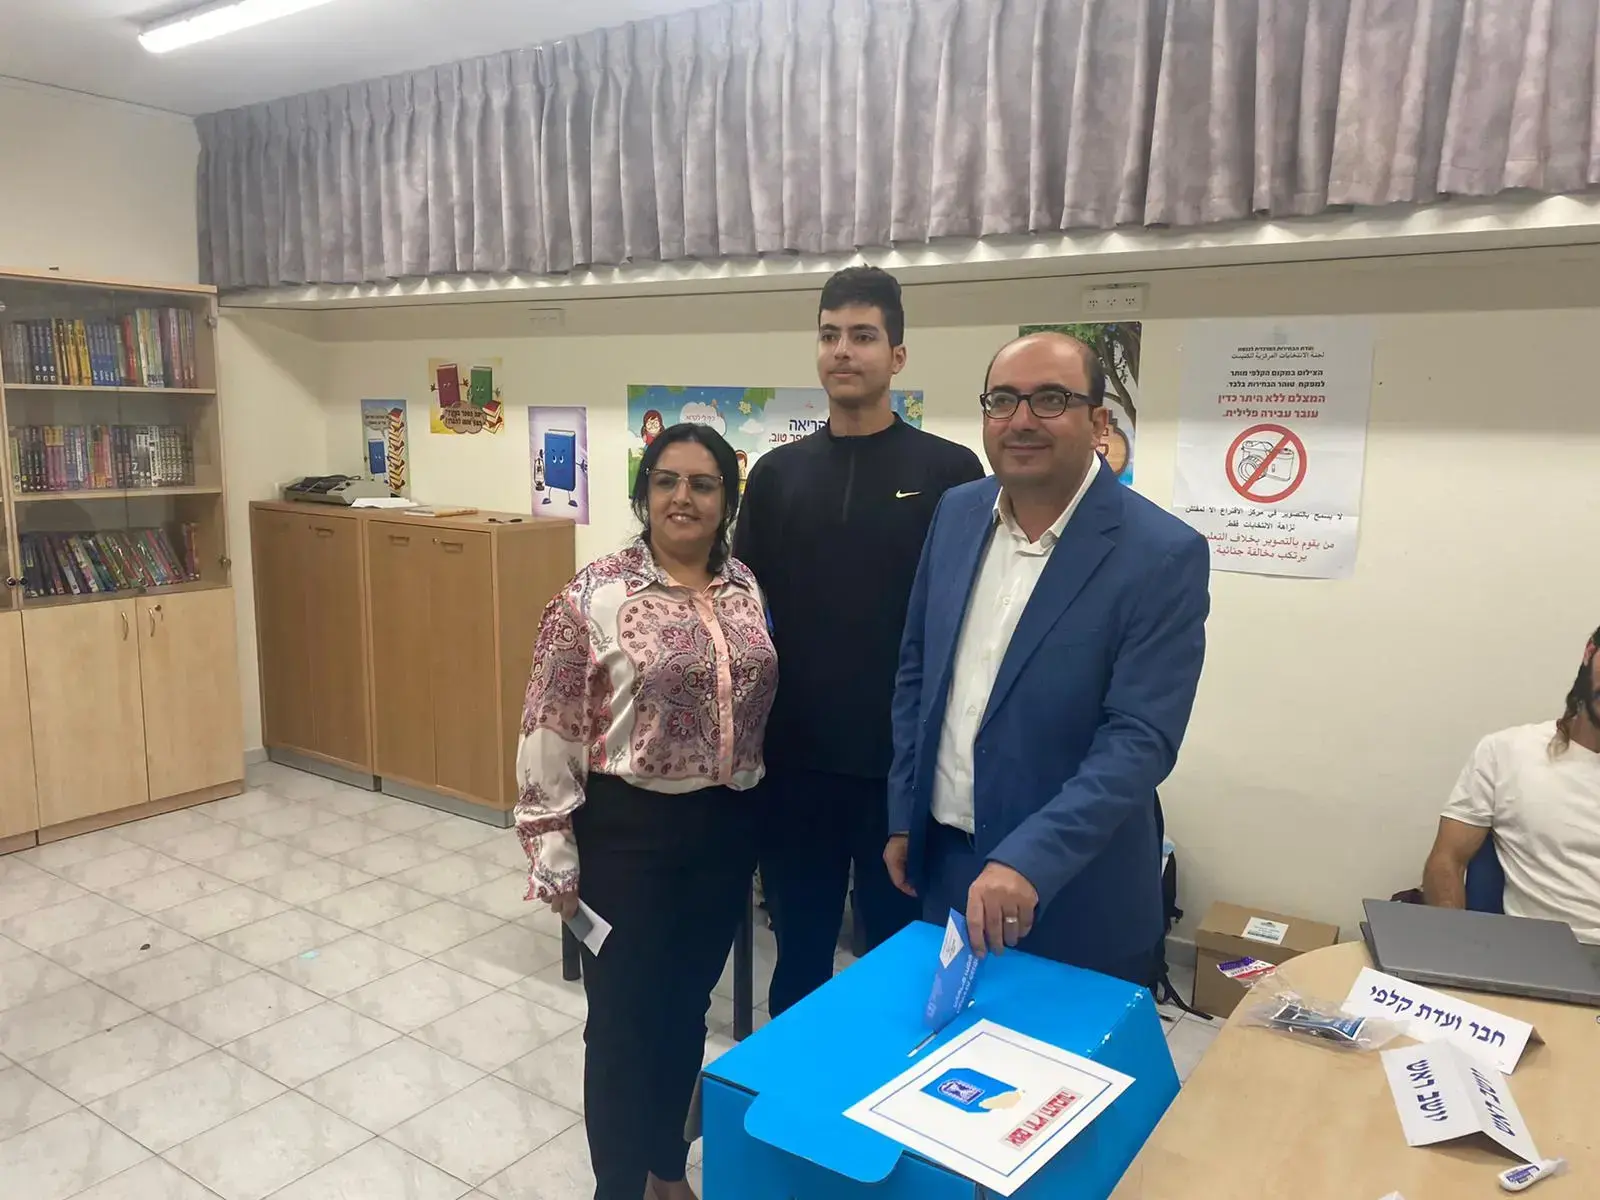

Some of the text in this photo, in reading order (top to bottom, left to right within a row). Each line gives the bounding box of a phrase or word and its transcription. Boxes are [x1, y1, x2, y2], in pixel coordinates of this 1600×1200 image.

[1249, 369, 1270, 377] הקלפי
[1218, 392, 1326, 404] המצלם ללא היתר כדין
[1222, 408, 1319, 418] עובר עבירה פלילית.
[1248, 508, 1264, 516] مركز
[1267, 509, 1277, 518] في
[1337, 512, 1343, 520] لا
[1277, 522, 1295, 532] نزاهة
[1230, 533, 1260, 545] بخلاف
[1262, 536, 1299, 547] بالتصوير
[1301, 539, 1320, 550] يقوم
[1323, 540, 1335, 550] من
[1247, 546, 1275, 557] مخالفة
[1277, 551, 1308, 563] يرتكب
[1369, 986, 1506, 1047] חבר ועדת קלפי
[1406, 1059, 1448, 1121] יושב ראש
